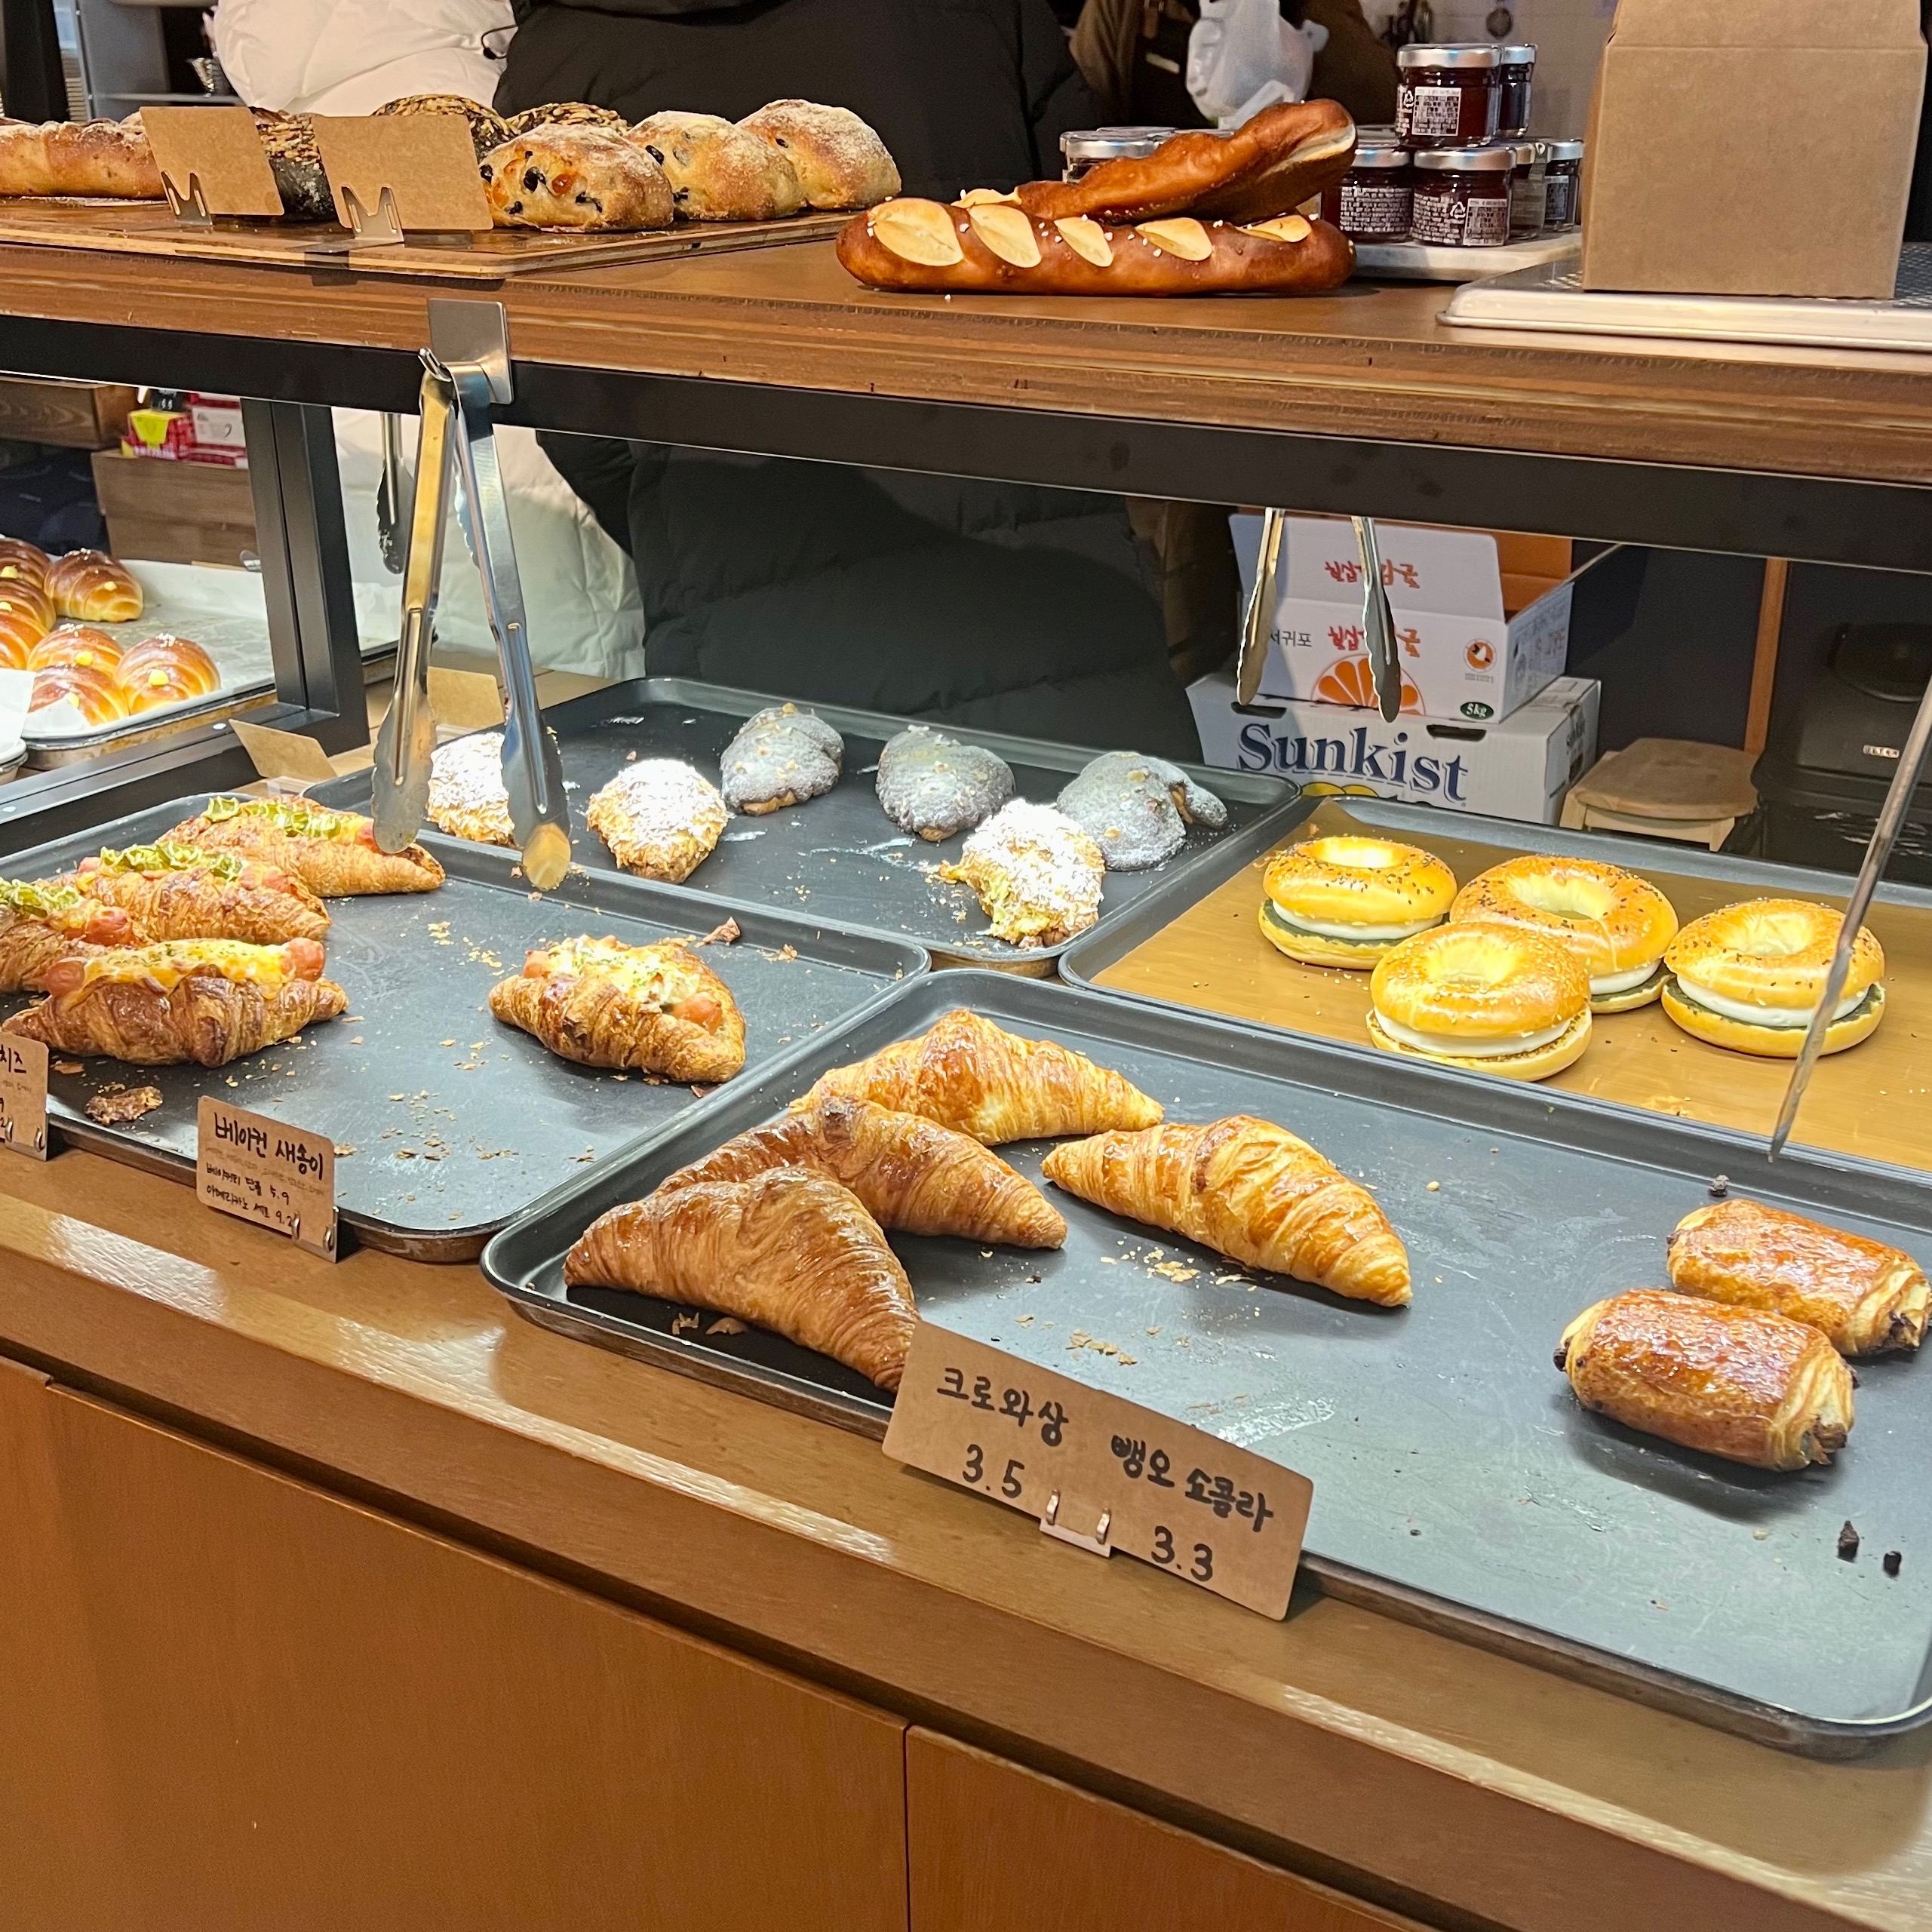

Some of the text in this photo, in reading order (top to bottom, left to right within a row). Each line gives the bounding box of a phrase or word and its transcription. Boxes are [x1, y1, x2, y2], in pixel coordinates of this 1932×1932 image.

[1270, 629, 1313, 647] 서귀포
[1466, 702, 1487, 717] 5kg
[1237, 723, 1469, 804] Sunkist
[214, 1112, 267, 1158] 베이컨
[275, 1139, 323, 1181] 새송이
[270, 1184, 290, 1206] 5.9
[937, 1367, 1069, 1447] 크로와상
[963, 1444, 1025, 1499] 3.5
[1151, 1525, 1213, 1582] 3.3
